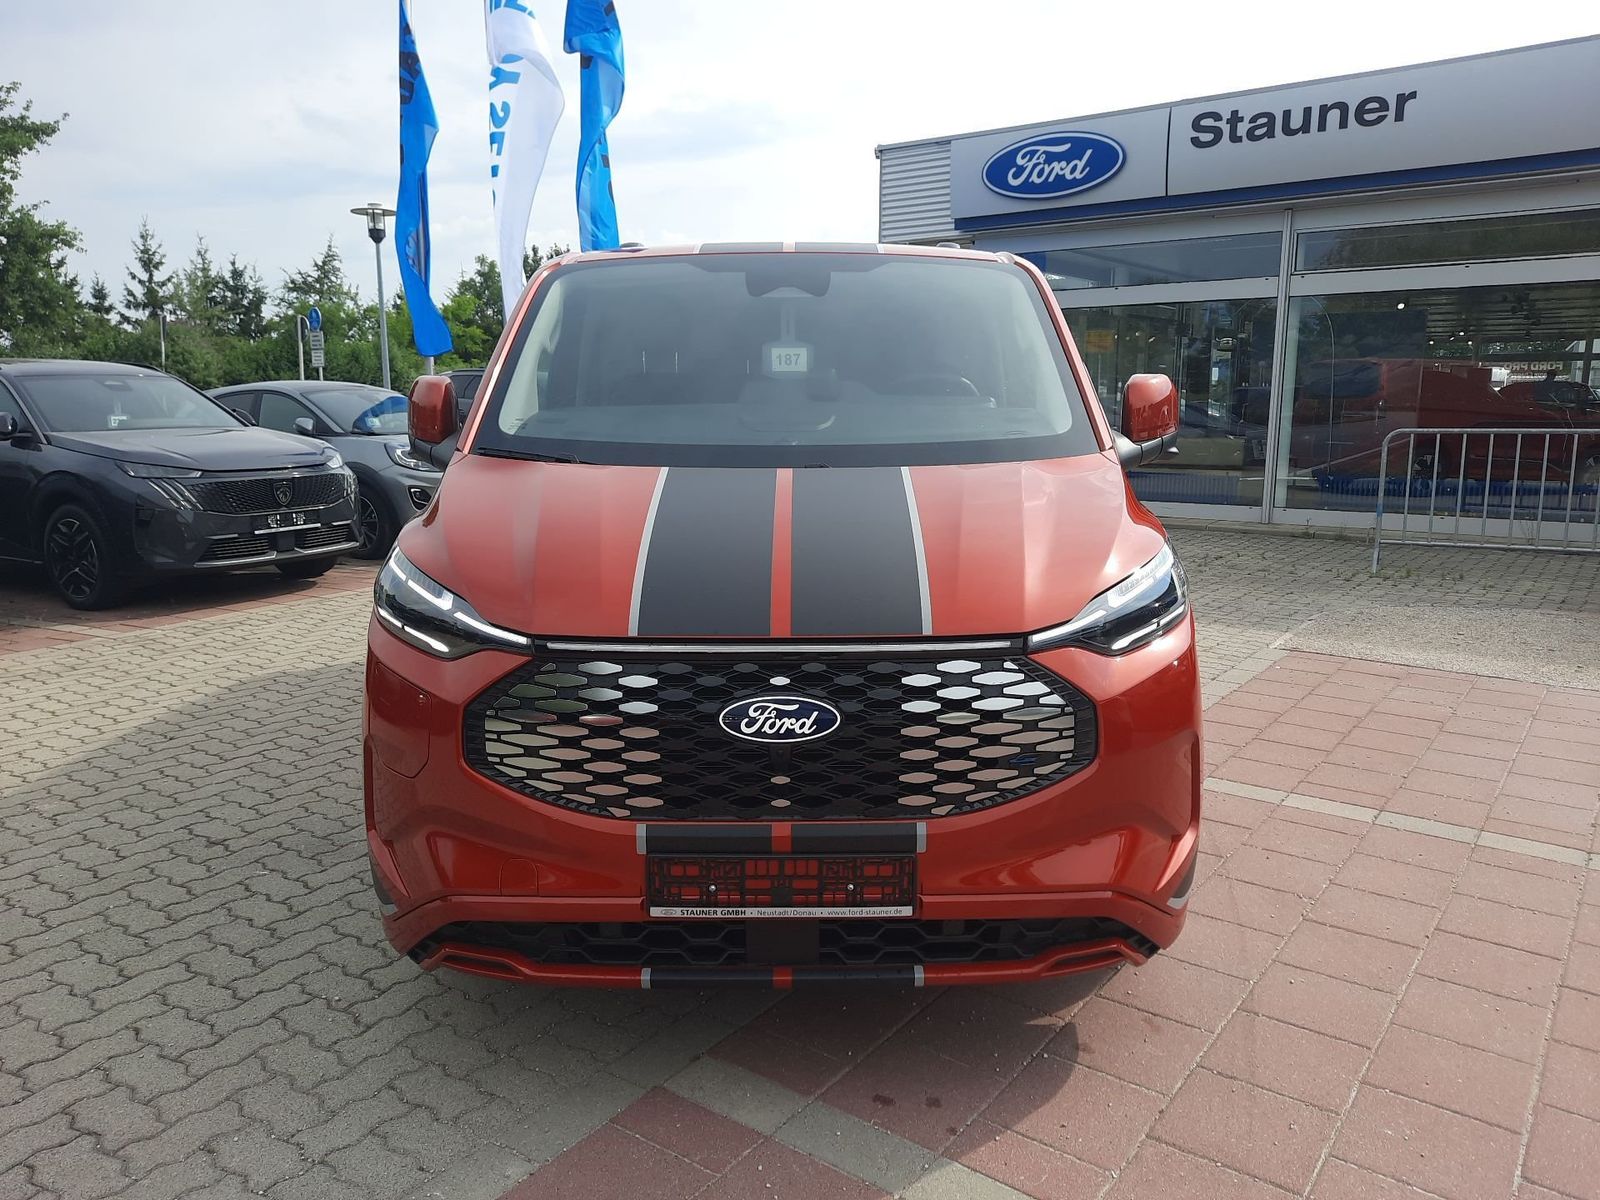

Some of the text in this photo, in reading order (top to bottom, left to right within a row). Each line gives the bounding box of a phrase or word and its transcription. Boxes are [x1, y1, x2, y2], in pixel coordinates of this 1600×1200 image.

[1190, 90, 1417, 149] Stauner
[1007, 143, 1093, 186] Ford
[776, 353, 800, 366] 187
[740, 702, 819, 734] Ford
[827, 908, 903, 916] www.ford-stauner.de
